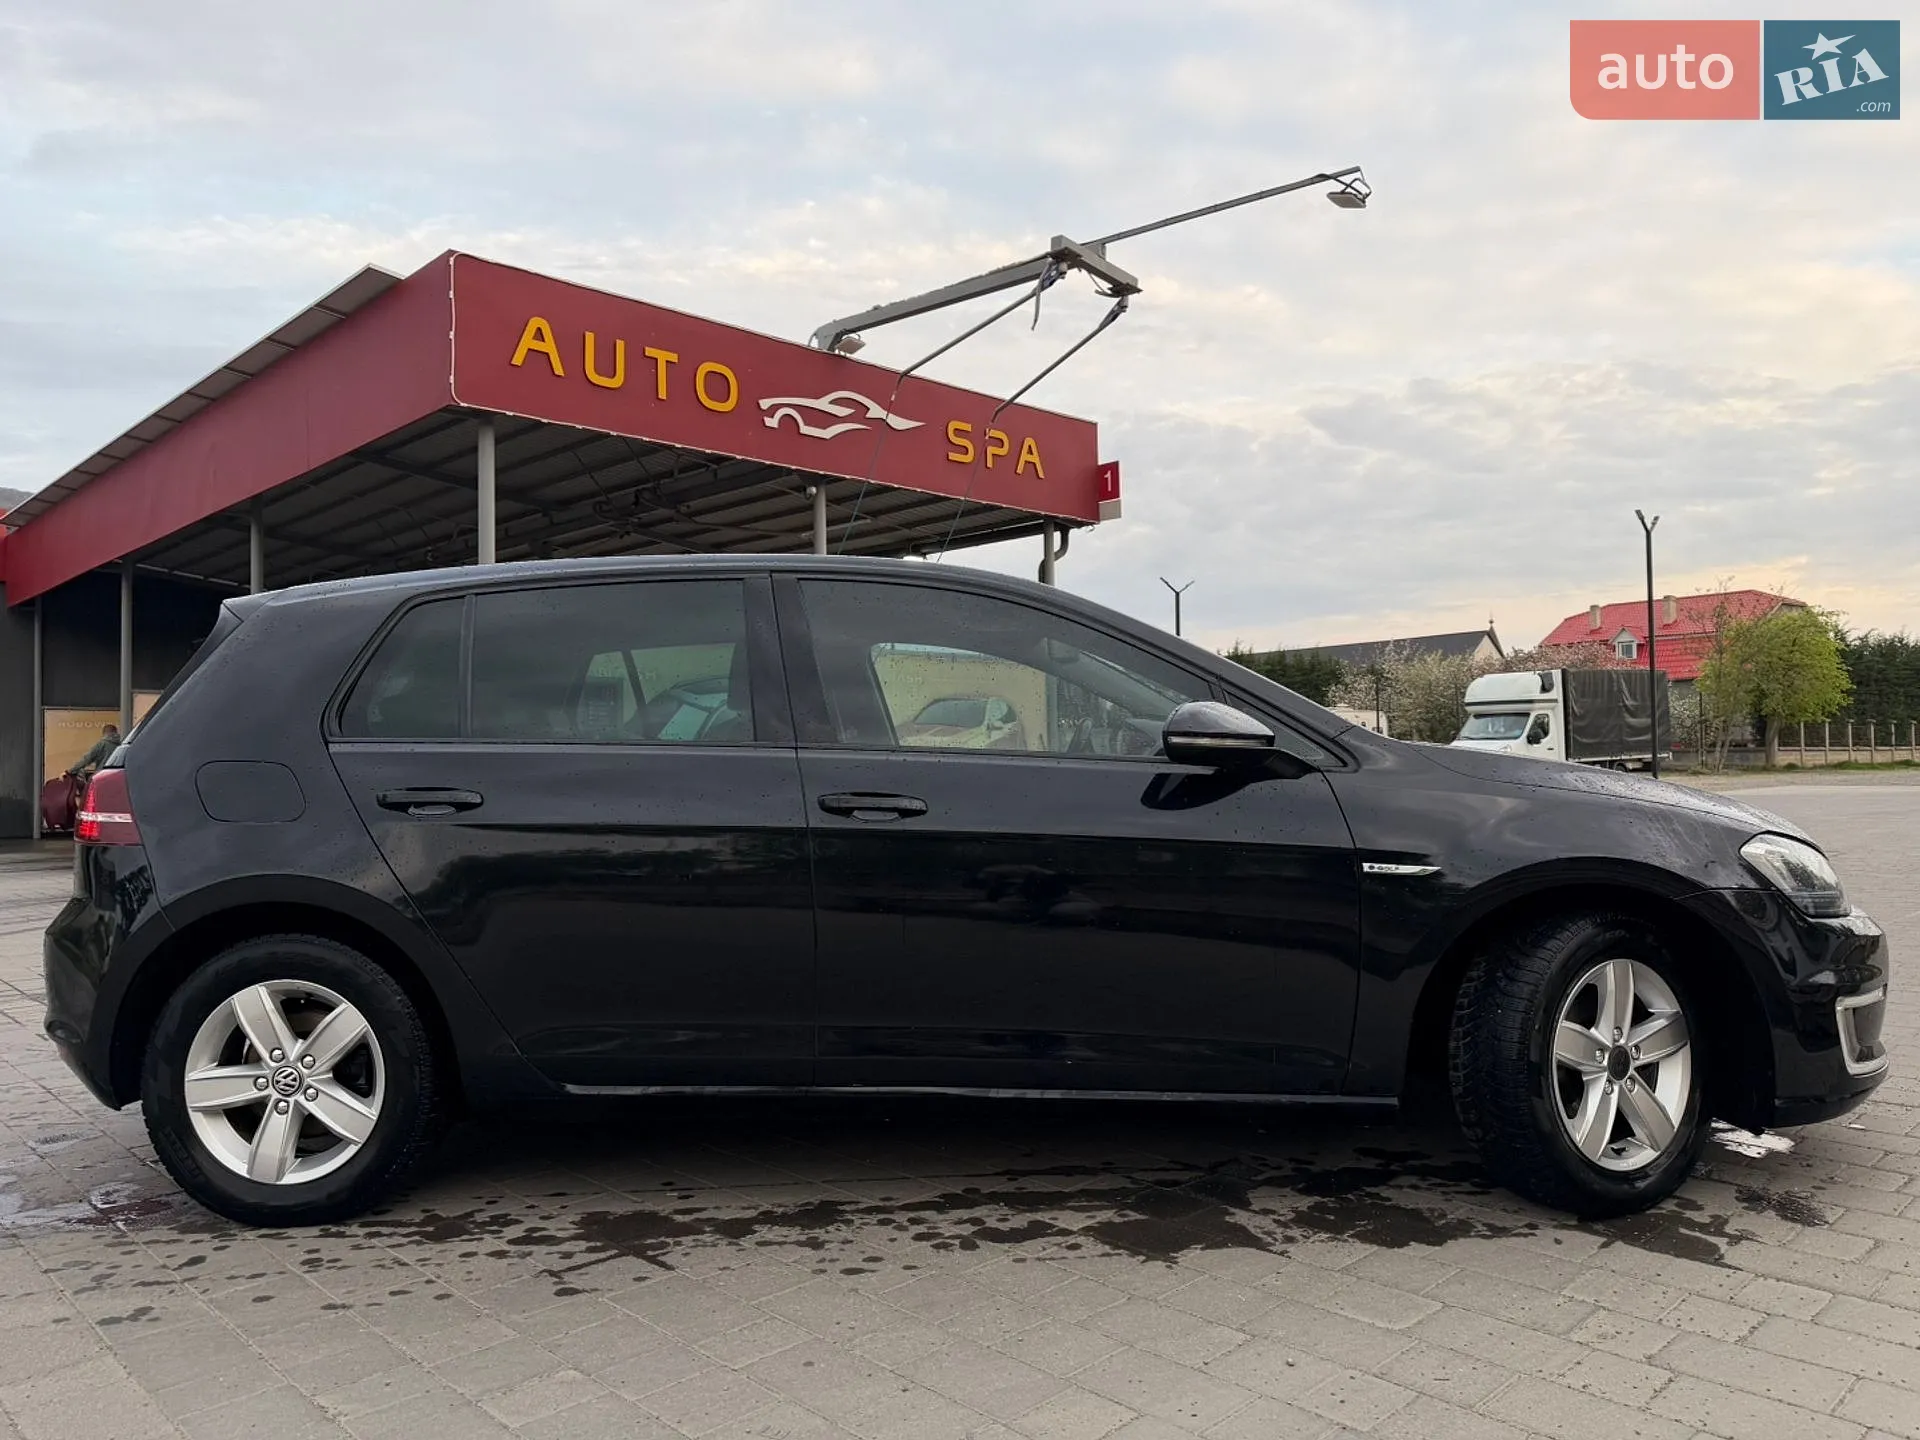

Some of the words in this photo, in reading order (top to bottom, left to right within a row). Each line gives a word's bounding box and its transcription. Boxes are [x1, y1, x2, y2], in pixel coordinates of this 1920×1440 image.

[510, 316, 739, 412] AUTO
[946, 420, 1045, 479] SPA
[1103, 470, 1112, 492] 1
